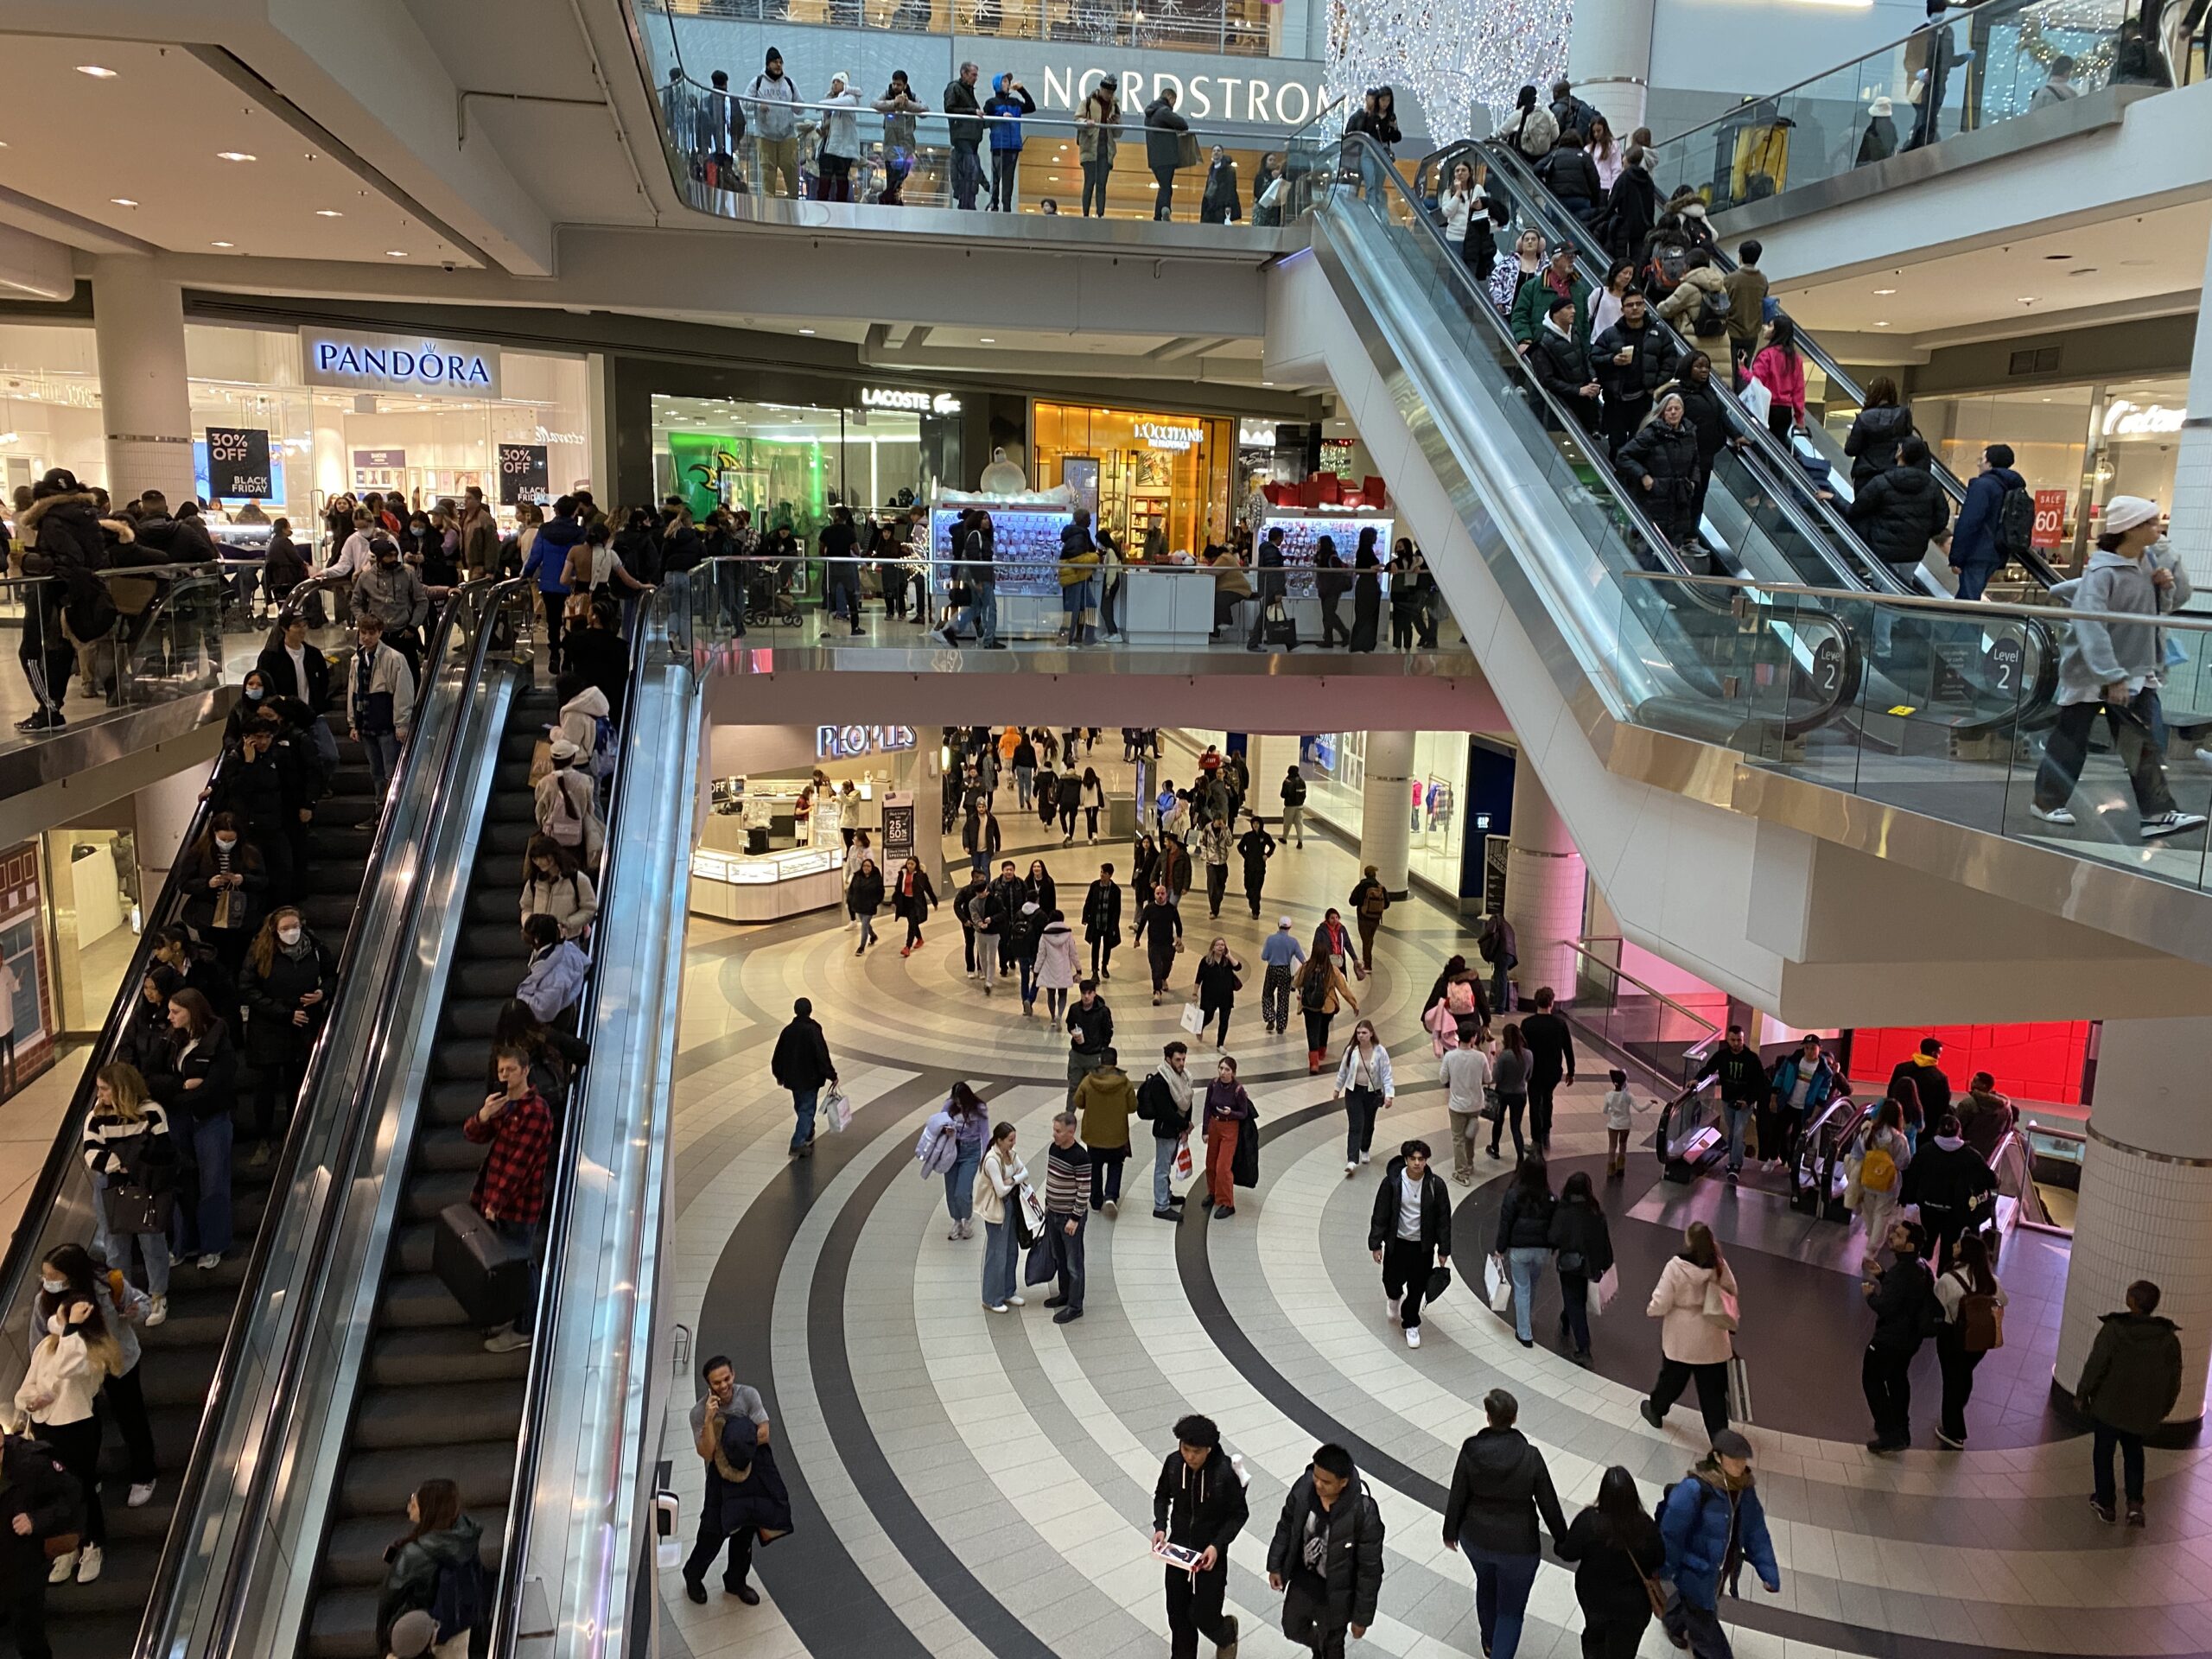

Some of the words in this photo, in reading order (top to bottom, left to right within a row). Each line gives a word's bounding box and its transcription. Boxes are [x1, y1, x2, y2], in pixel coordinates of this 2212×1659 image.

[319, 344, 489, 382] PANDORA
[861, 387, 931, 410] LACOSTE
[212, 433, 248, 448] 30%
[213, 448, 247, 461] OFF
[503, 449, 531, 461] 30%
[503, 461, 531, 474] OFF
[233, 475, 267, 485] BLACK
[232, 484, 267, 493] FRIDAY
[518, 493, 546, 502] FRIDAY
[2040, 495, 2061, 504] SALE
[1993, 648, 2018, 663] Level
[1824, 664, 1835, 690] 2
[1997, 664, 2011, 690] 2
[817, 725, 917, 756] PEOPLES
